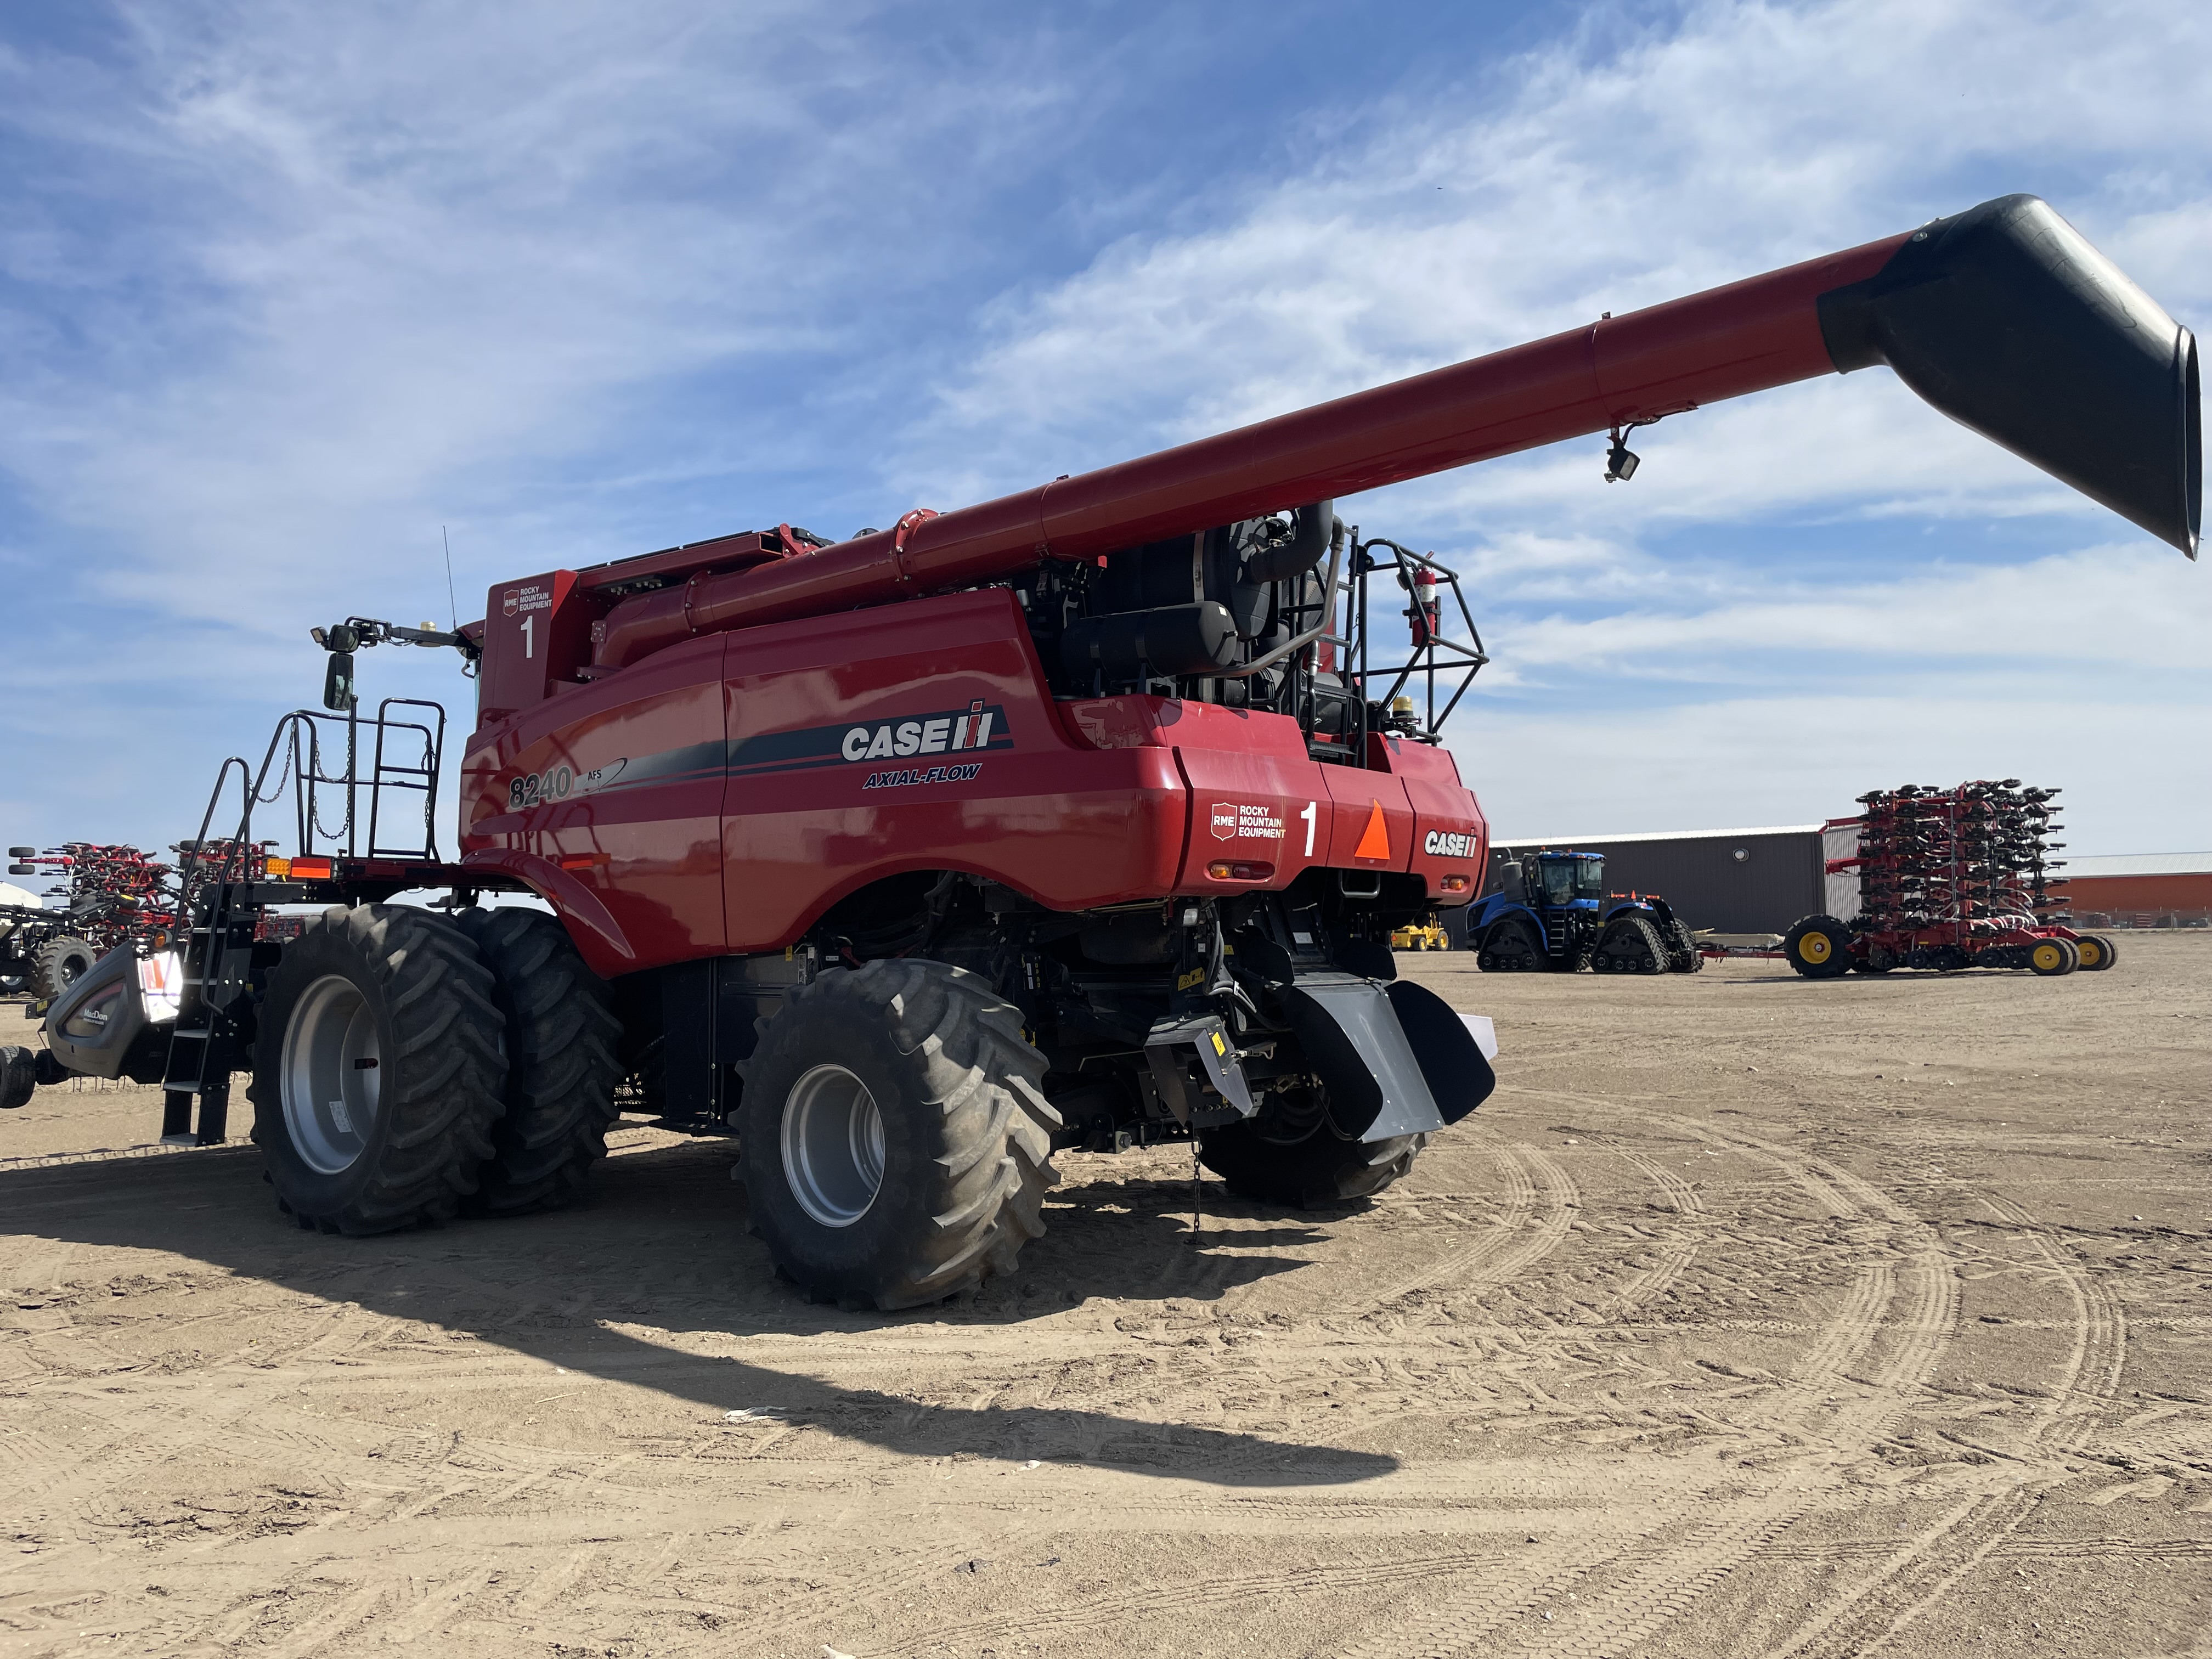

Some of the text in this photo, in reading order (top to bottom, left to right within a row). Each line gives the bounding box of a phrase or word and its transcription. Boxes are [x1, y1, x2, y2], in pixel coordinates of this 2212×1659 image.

[521, 585, 540, 595] ROCKY
[505, 598, 517, 607] RME
[520, 591, 549, 603] MOUNTAIN
[520, 599, 552, 612] EQUIPMENT
[521, 615, 533, 658] 1
[842, 718, 951, 761] CASE
[862, 763, 983, 789] AXIAL-FLOW
[509, 765, 602, 810] 8240 AFS
[1240, 805, 1269, 816] ROCKY
[1214, 815, 1234, 827] RME
[1239, 816, 1282, 828] MOUNTAIN
[1238, 827, 1286, 839] EQUIPMENT
[1301, 802, 1316, 856] 1
[1425, 831, 1465, 856] CASE
[84, 1008, 108, 1021] MacDon
